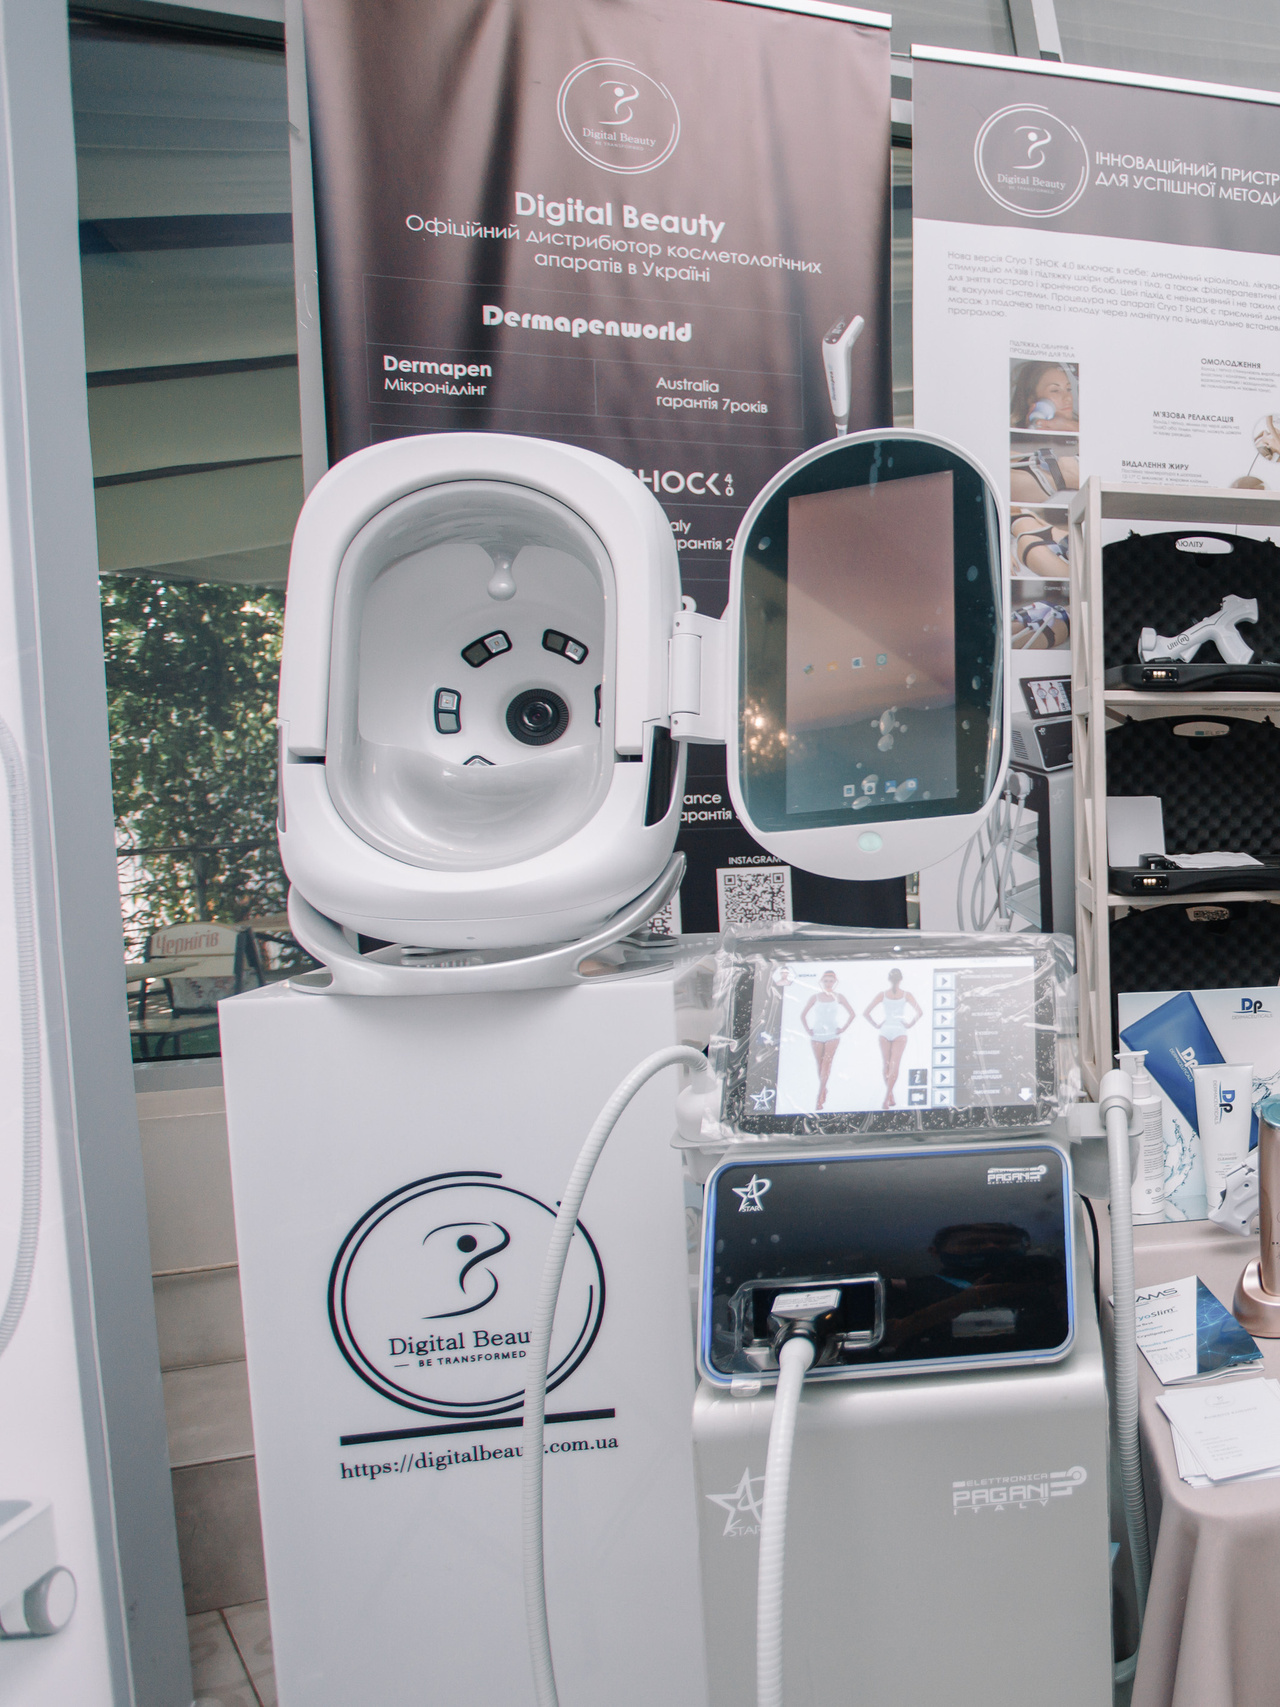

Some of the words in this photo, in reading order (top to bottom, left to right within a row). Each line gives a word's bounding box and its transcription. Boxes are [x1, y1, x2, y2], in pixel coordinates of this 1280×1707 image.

[583, 127, 617, 141] Digital
[620, 132, 656, 147] Beauty
[1095, 151, 1217, 179] ІННОВАЦІЙНИЙ
[997, 173, 1029, 185] Digital
[1032, 176, 1066, 190] Beauty
[1095, 171, 1129, 188] ДЛЯ
[1133, 175, 1215, 198] УСПІШНОЇ
[514, 191, 613, 227] Digital
[623, 204, 726, 243] Beauty
[405, 214, 521, 241] Офіційний
[525, 229, 662, 258] дистрибютор
[667, 243, 823, 275] косметологічних
[946, 251, 971, 259] Нова
[973, 254, 1002, 263] версія
[534, 250, 623, 275] апаратів
[628, 263, 637, 276] в
[642, 260, 711, 284] Україні
[482, 304, 693, 343] Dermapenworld
[383, 354, 493, 379] Dermapen
[1200, 358, 1261, 369] ОМОЛОДЖЕННЯ
[384, 377, 488, 396] Мікронідлінг
[656, 377, 720, 393] Australia
[656, 395, 719, 410] гарантія
[722, 398, 768, 414] 7років
[1188, 413, 1234, 423] РЕЛАКСАЦІЯ
[1121, 460, 1166, 469] ВИДАЛЕННЯ
[626, 468, 721, 496] HOCK
[675, 537, 722, 551] рантія
[728, 855, 782, 865] INSTAGRAM
[1241, 998, 1263, 1013] Dp
[1219, 1089, 1236, 1113] Dp
[388, 1331, 466, 1357] Digital
[473, 1329, 532, 1349] Beau
[418, 1358, 432, 1368] BE
[437, 1349, 527, 1366] TRANSFORMED
[340, 1436, 619, 1480] https://digitalbeau.com.ua
[966, 1473, 1048, 1487] ELETTRONICA
[953, 1483, 1049, 1507] PAGANI
